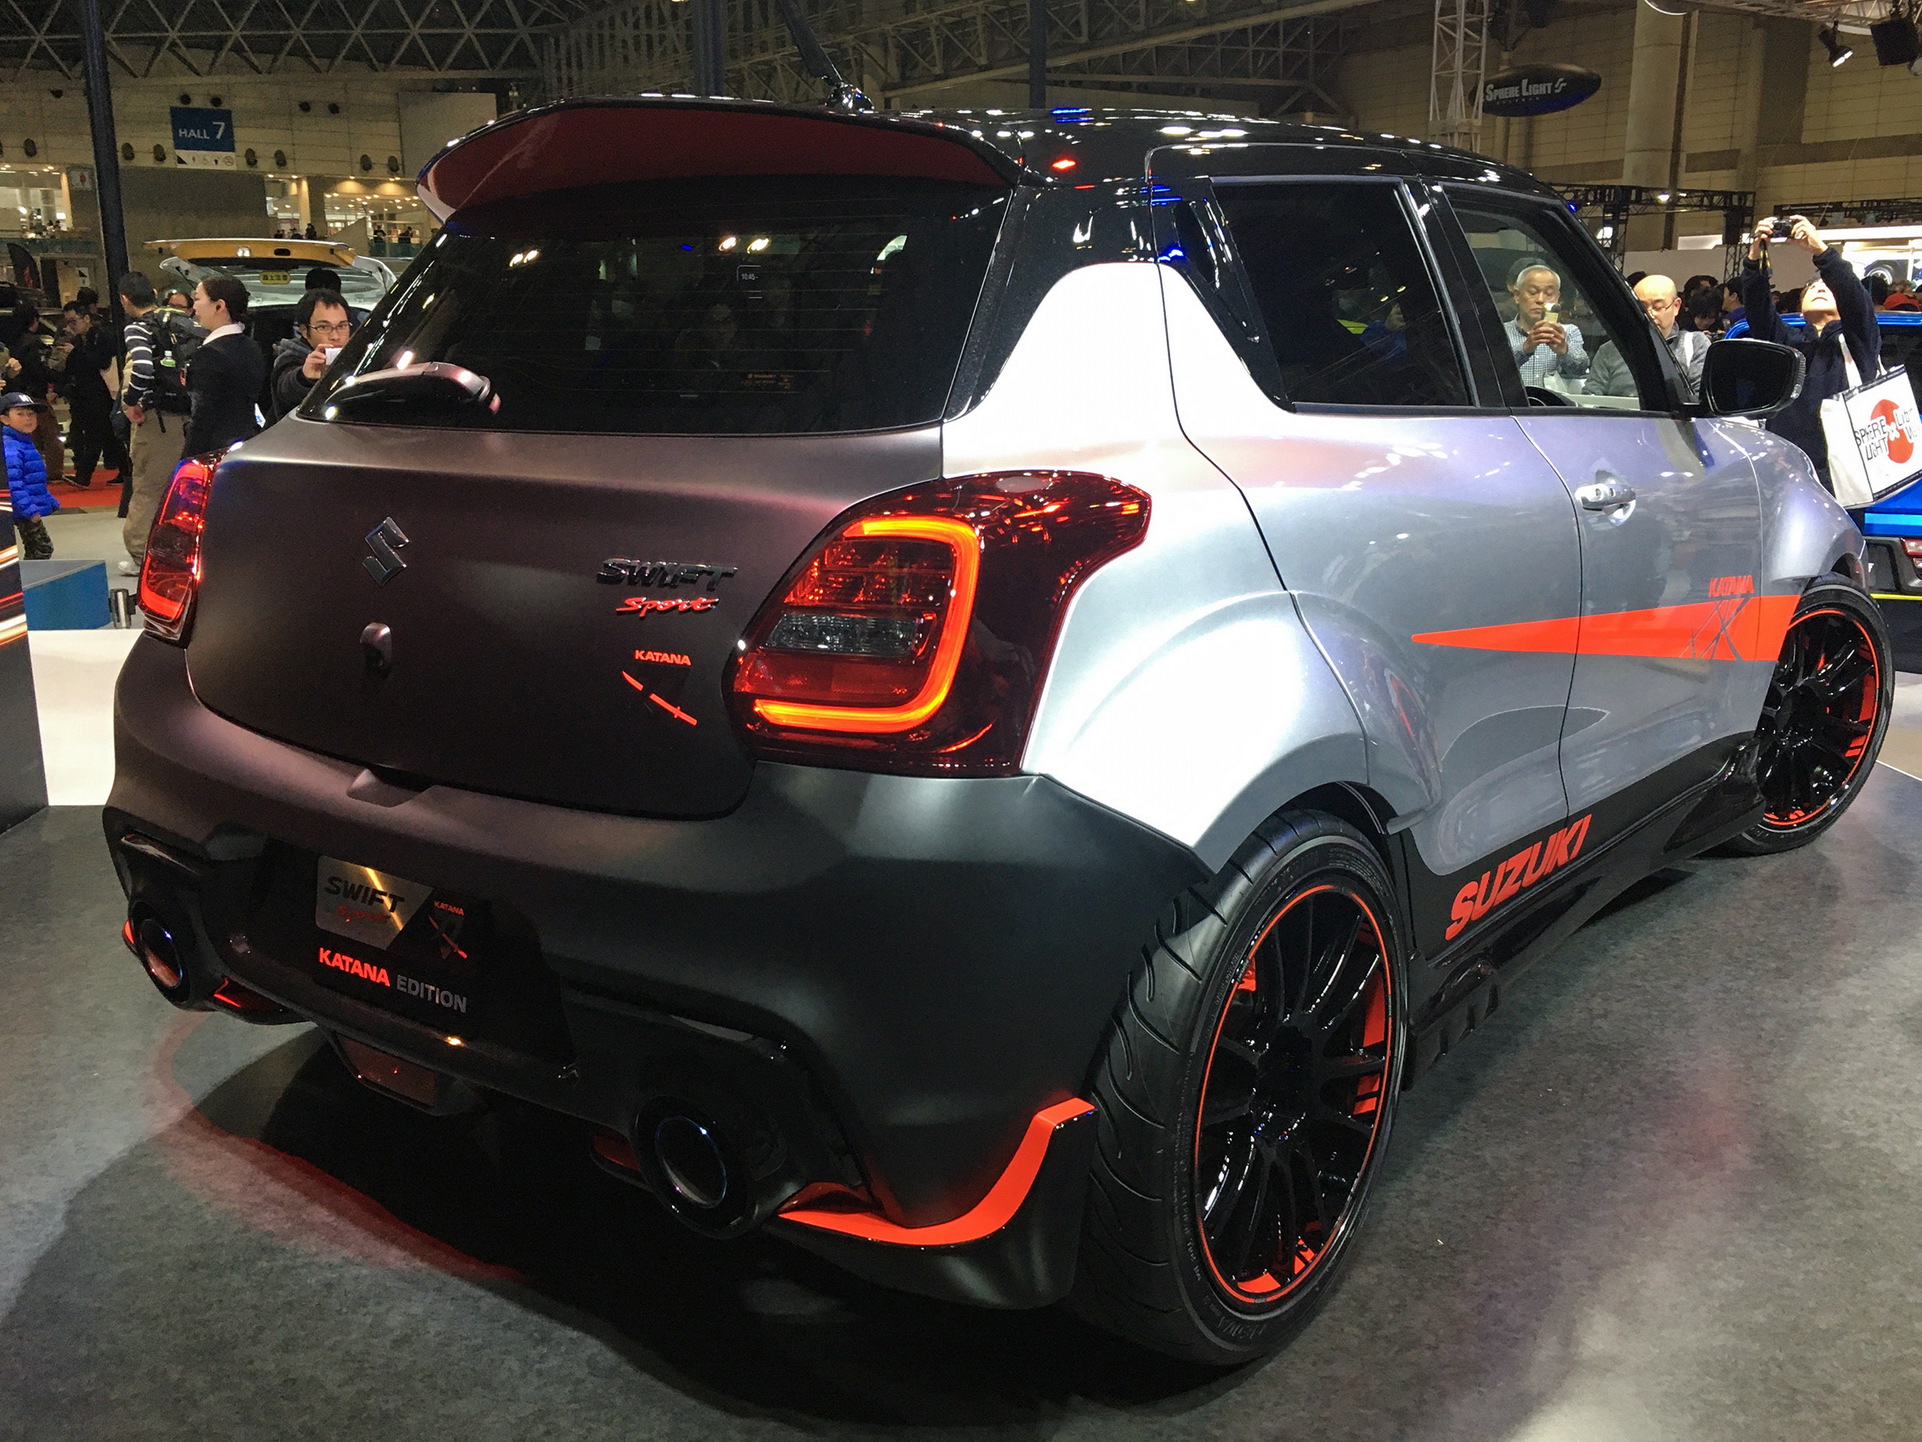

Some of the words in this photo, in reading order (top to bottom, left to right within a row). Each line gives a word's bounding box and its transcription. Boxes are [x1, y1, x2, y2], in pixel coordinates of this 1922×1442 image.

[178, 128, 210, 139] HALL
[212, 121, 226, 139] 7
[597, 557, 739, 592] SWIFT
[1708, 574, 1755, 598] KATANA
[615, 596, 720, 619] Sport
[635, 649, 692, 666] KATANA
[1445, 813, 1593, 941] SUZUKI
[324, 875, 405, 913] SWIFT
[433, 900, 465, 916] KATANA
[318, 947, 391, 987] KATANA
[396, 974, 467, 1014] EDITION
